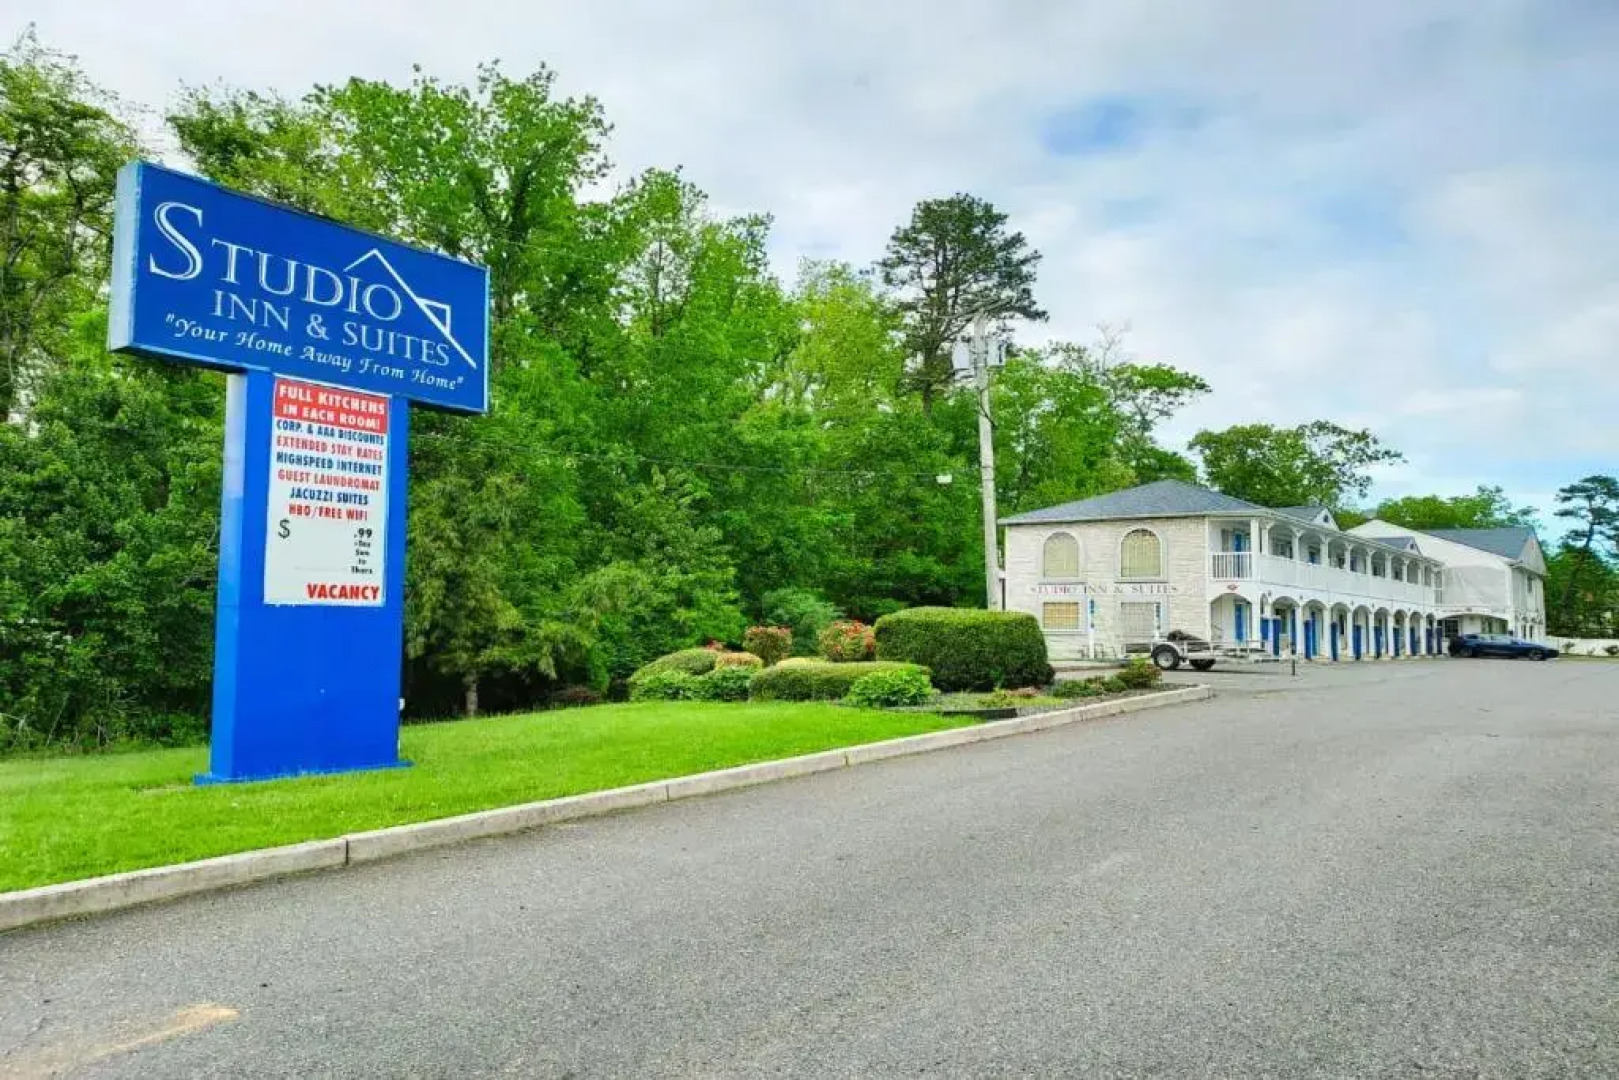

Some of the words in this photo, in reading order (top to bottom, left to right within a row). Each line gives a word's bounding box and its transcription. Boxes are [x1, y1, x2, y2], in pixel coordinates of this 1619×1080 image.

[150, 201, 402, 322] STUDIO
[210, 290, 290, 331] INN
[306, 313, 330, 341] &
[342, 321, 450, 366] SUITES
[235, 331, 292, 356] Home
[300, 345, 351, 373] Away
[358, 358, 404, 380] From
[280, 384, 313, 403] FULL
[318, 391, 385, 415] KITCHENS
[283, 404, 298, 415] IN
[302, 407, 335, 422] EACH
[277, 419, 303, 433] CORP.
[307, 423, 314, 434] &
[318, 425, 335, 438] AAA
[338, 429, 384, 446] DISCOUNTS
[277, 436, 327, 453] EXTENDED
[331, 443, 352, 456] STAY
[357, 447, 383, 461] RATES
[277, 452, 333, 470] HIGHSPEED
[337, 460, 382, 477] INTERNET
[278, 469, 311, 483] GUEST
[315, 473, 380, 491] LAUNDROMAT
[290, 487, 333, 502] JACUZZI
[337, 492, 368, 505] SUITES
[278, 518, 291, 539] $
[307, 583, 380, 600] VACANCY
[1084, 584, 1108, 594] INN
